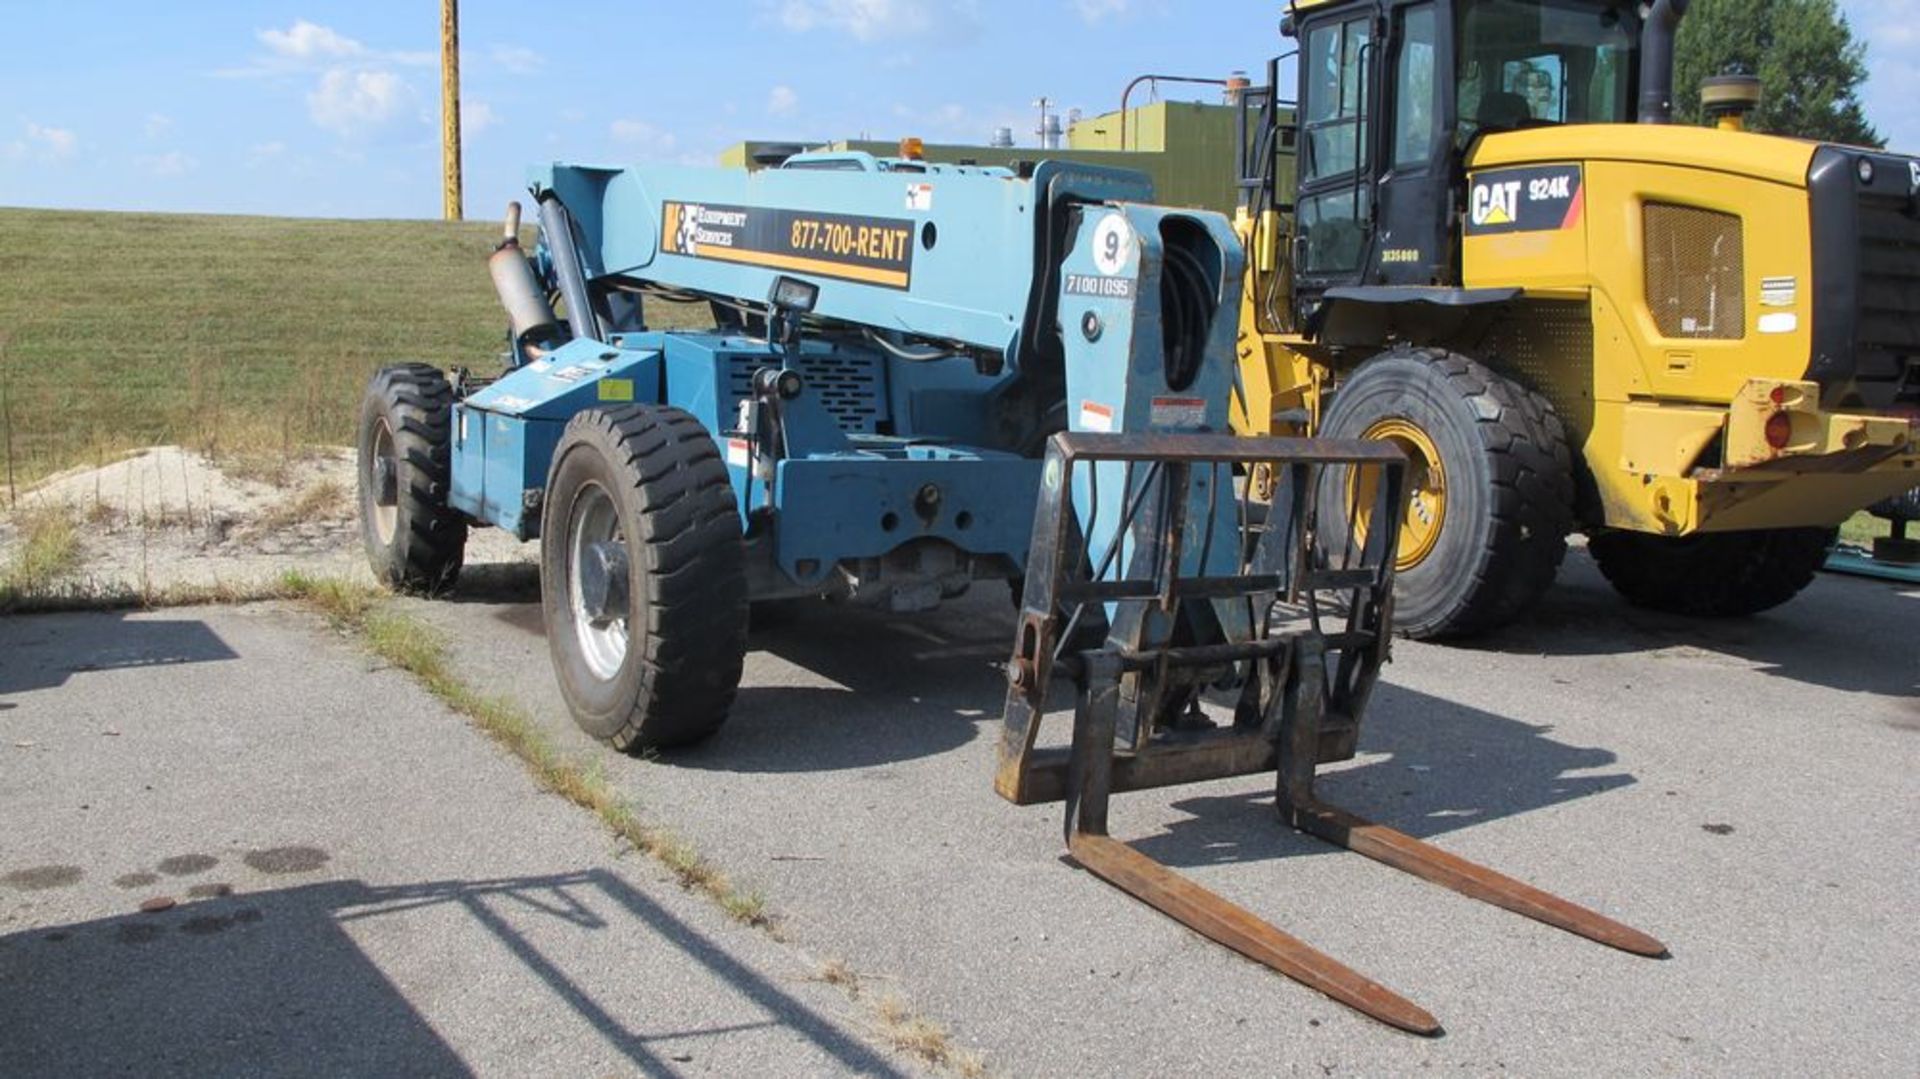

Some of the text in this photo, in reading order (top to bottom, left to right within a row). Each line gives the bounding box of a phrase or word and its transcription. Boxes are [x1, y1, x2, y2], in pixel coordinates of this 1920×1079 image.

[1529, 175, 1570, 201] 924K
[1472, 180, 1521, 225] CAT
[695, 226, 733, 246] SERVICES
[791, 219, 908, 261] 877-700-RENT
[1104, 230, 1118, 260] 9
[1067, 275, 1128, 296] 71001095
